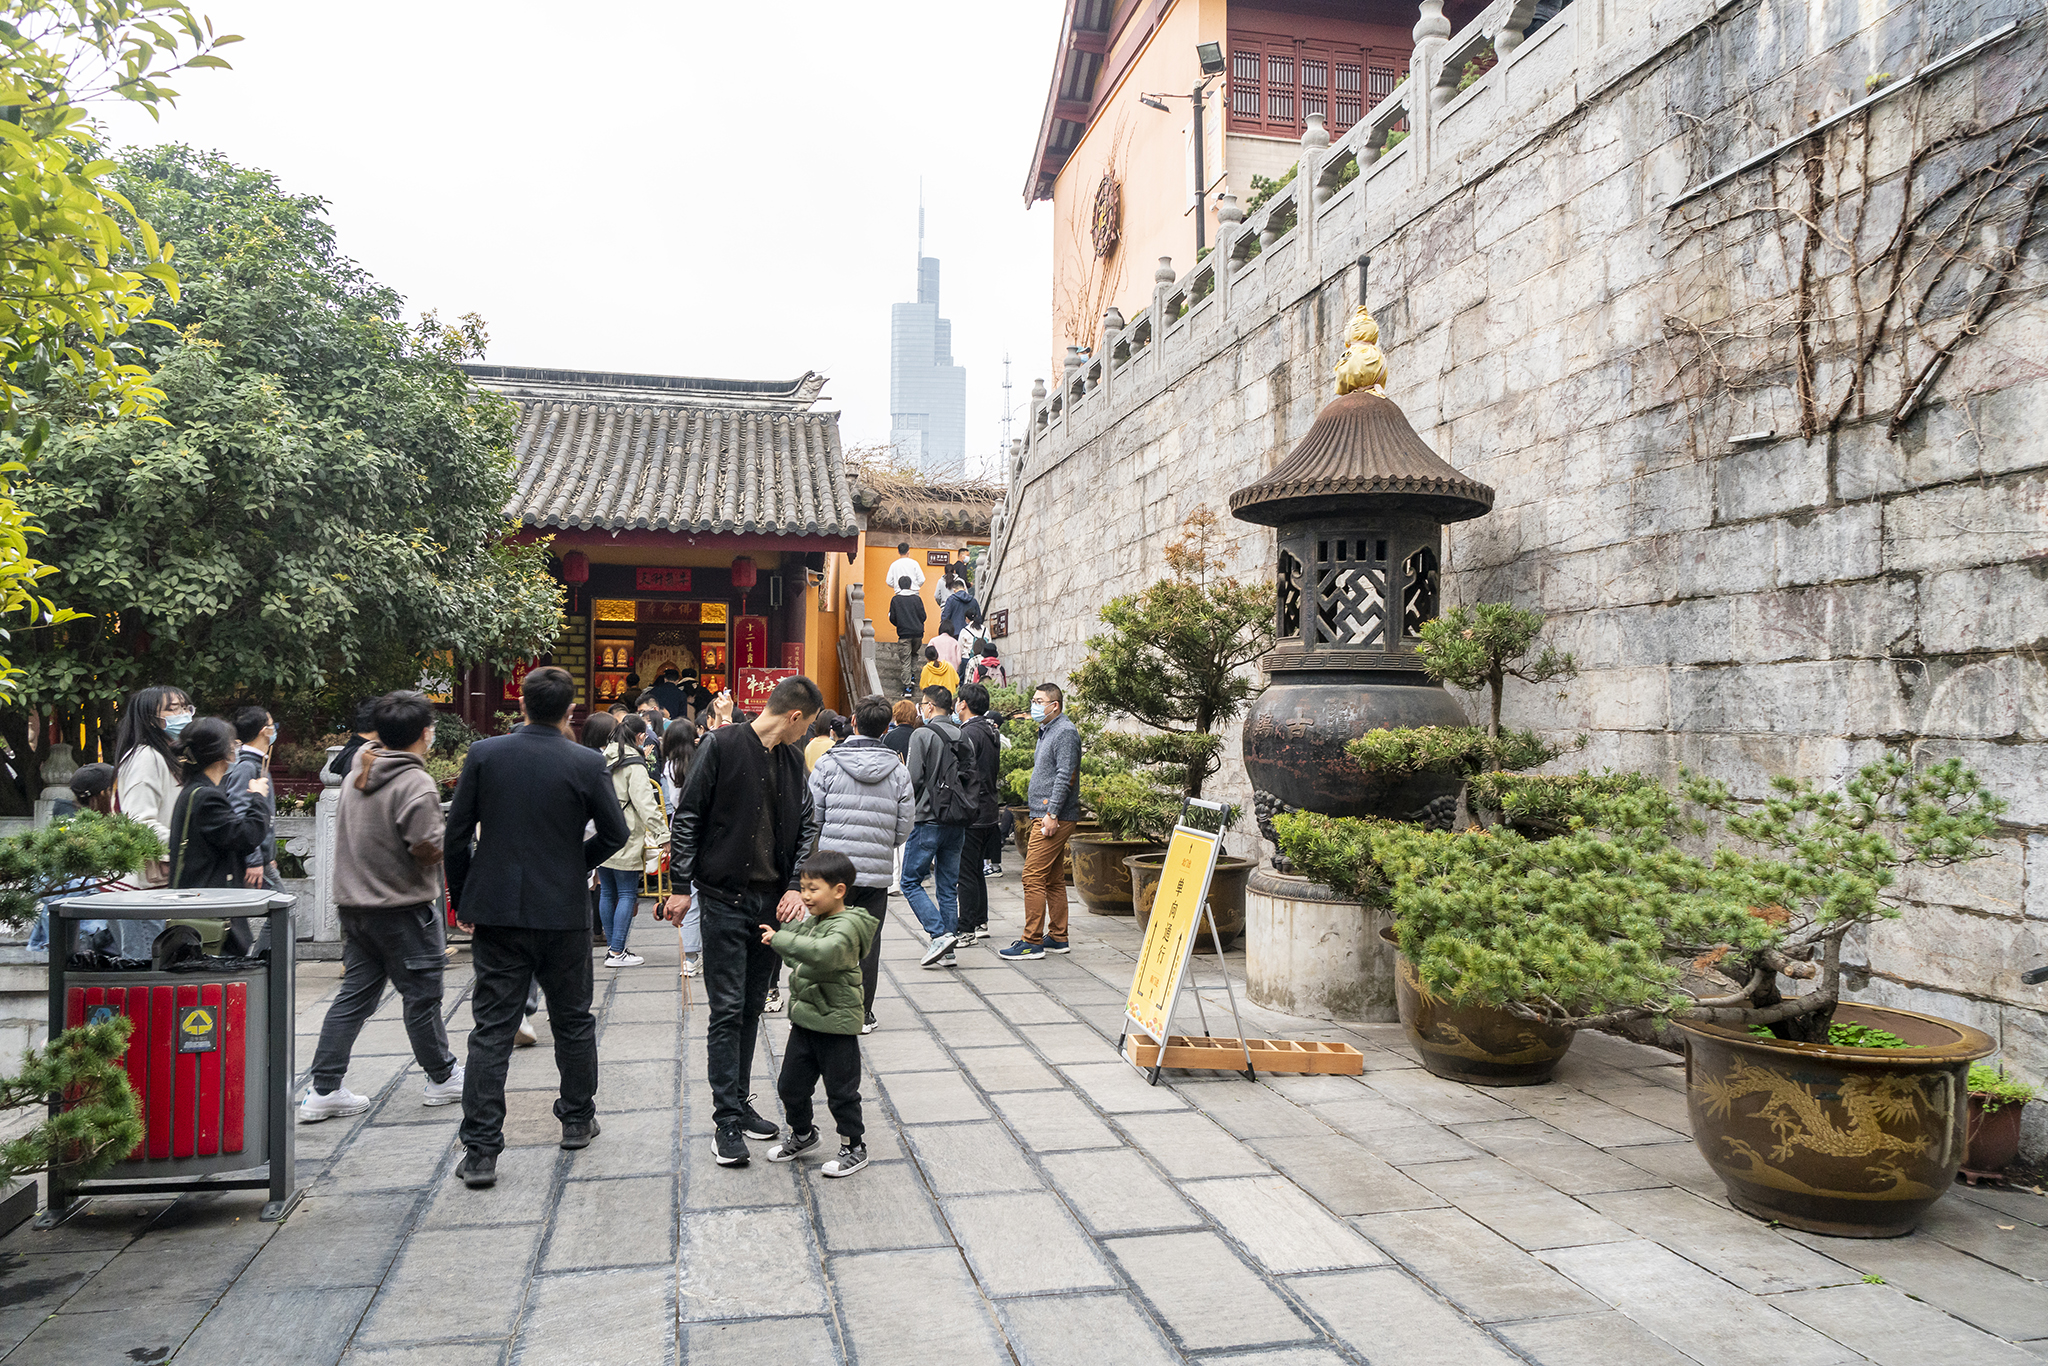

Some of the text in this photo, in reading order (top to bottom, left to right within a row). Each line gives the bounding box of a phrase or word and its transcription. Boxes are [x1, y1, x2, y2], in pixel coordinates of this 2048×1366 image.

[746, 674, 787, 698] 牛年大
[1157, 878, 1184, 965] 单向通行
